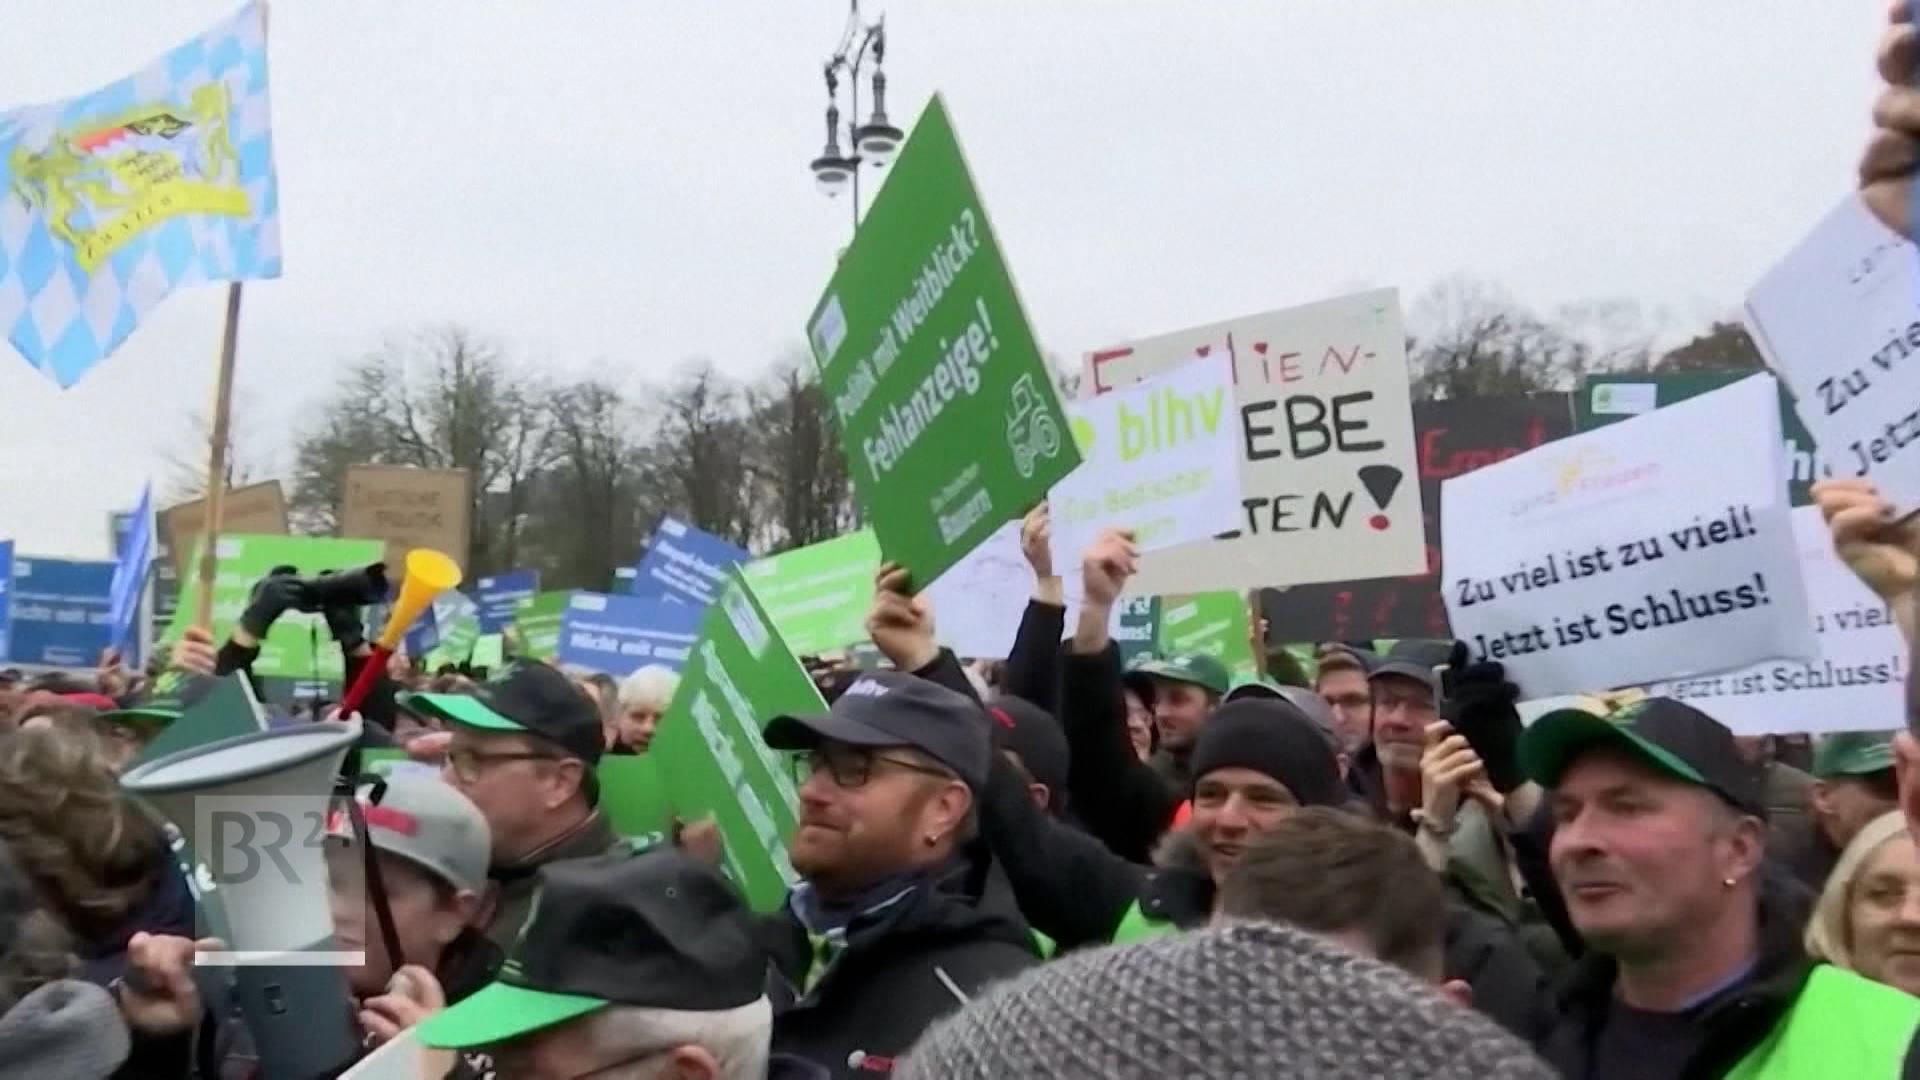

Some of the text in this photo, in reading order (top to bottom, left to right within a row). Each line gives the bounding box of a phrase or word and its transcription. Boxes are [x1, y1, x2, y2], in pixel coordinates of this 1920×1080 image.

[892, 207, 979, 343] Weitblick?
[863, 297, 999, 482] Fehlanzeige!
[1816, 319, 1920, 416] Zu vie
[1116, 386, 1225, 462] blhv
[1240, 391, 1385, 461] EBE
[1849, 408, 1920, 477] Jetz
[1212, 464, 1404, 541] TEN!
[1456, 504, 1757, 608] Zu viel ist zu viel!
[1474, 625, 1550, 663] Jetzt
[1554, 612, 1601, 647] ist
[1605, 572, 1771, 636] Schluss!
[1672, 655, 1906, 700] etzt ist Schluss!
